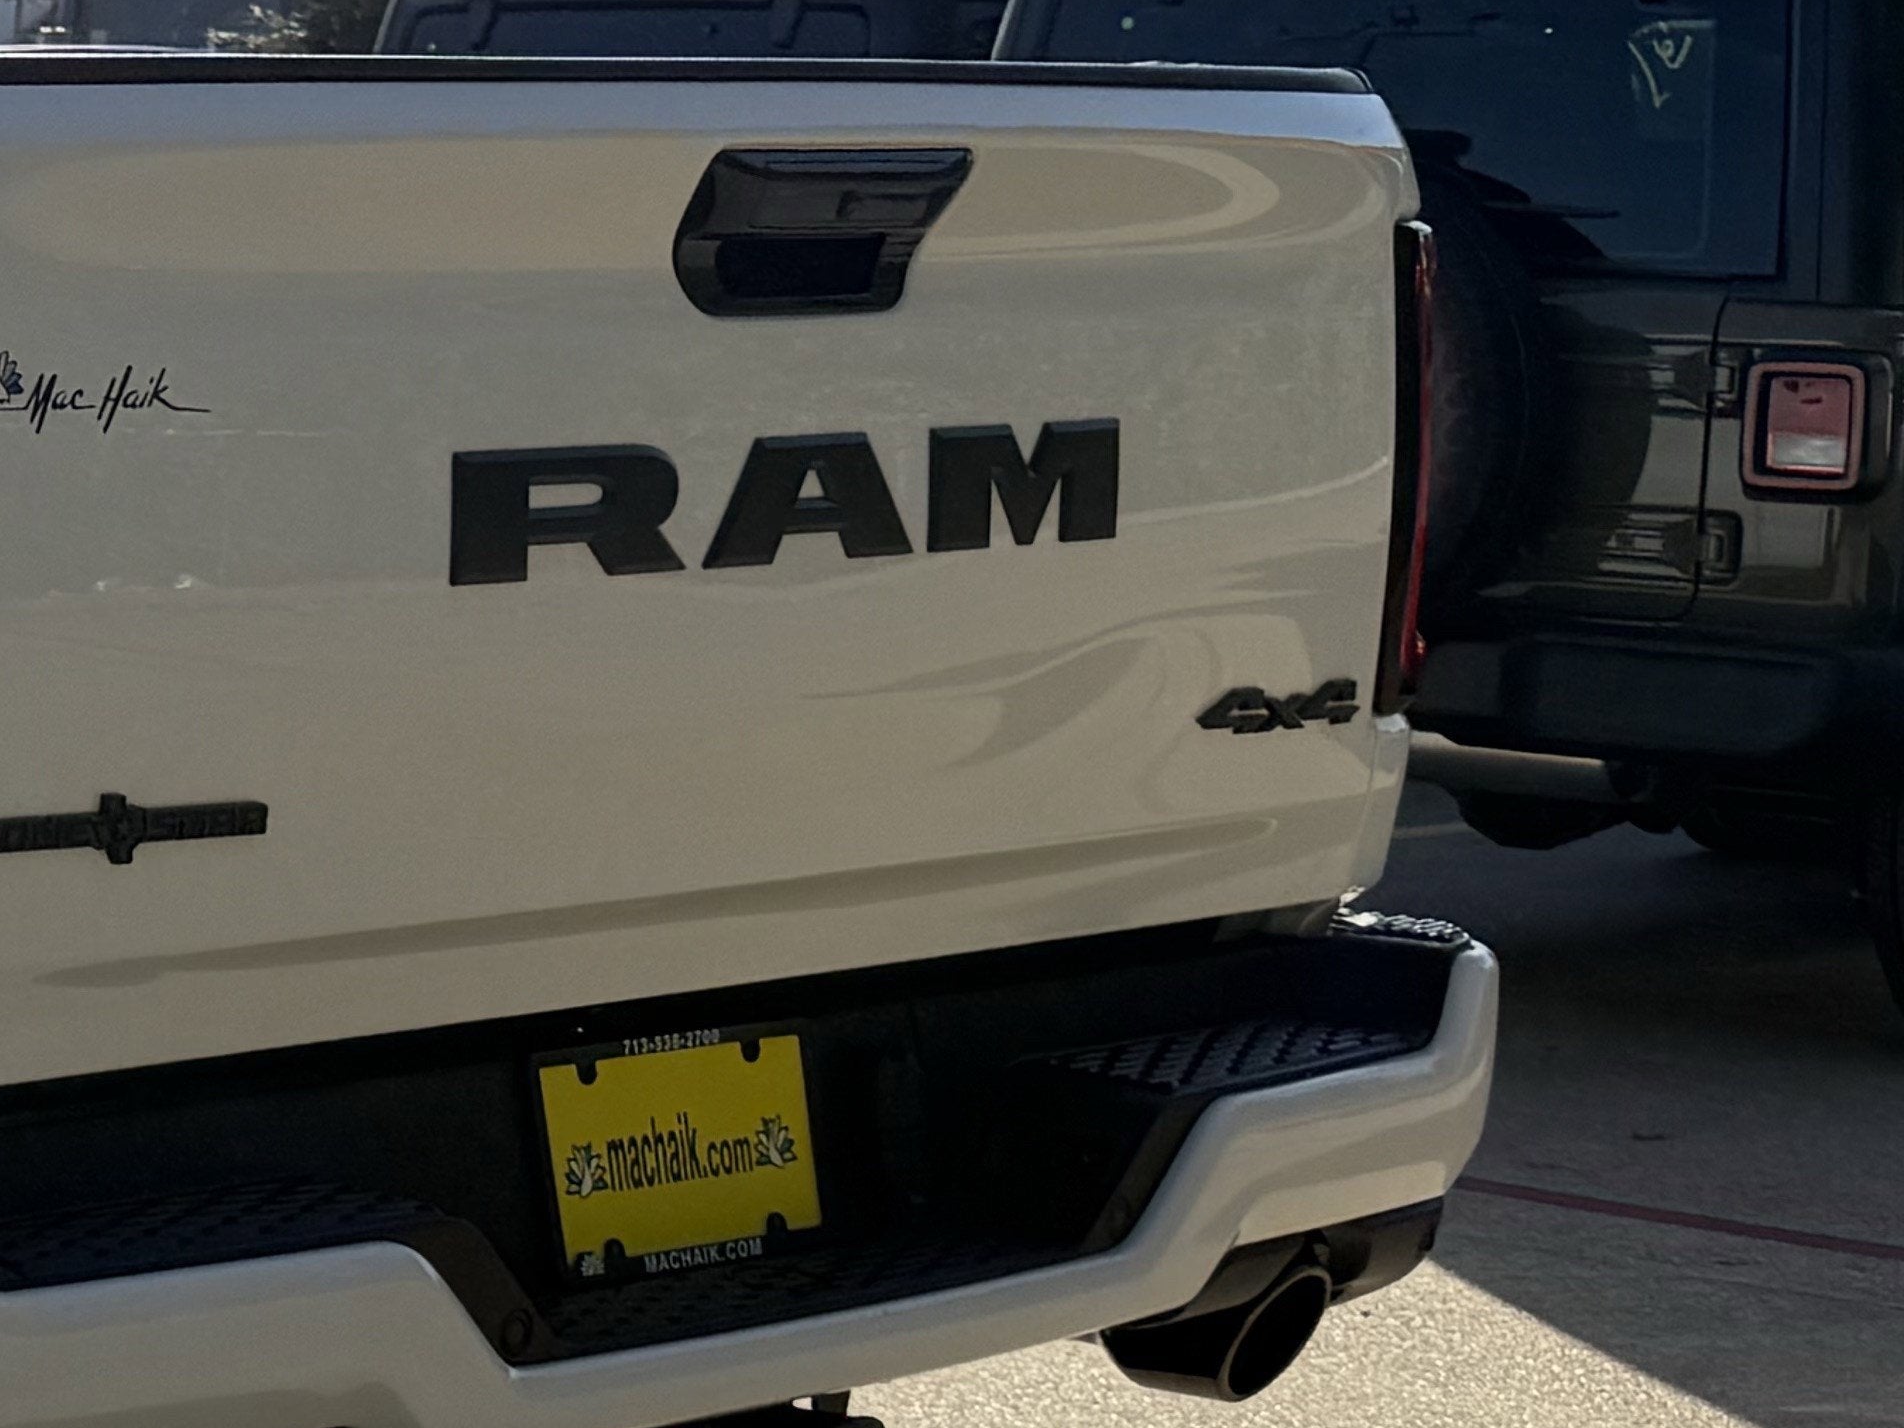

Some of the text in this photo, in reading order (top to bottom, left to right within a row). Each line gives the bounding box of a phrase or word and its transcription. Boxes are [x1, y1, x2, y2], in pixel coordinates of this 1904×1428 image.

[23, 365, 211, 434] Mac Haik
[449, 417, 1120, 586] RAM
[1195, 678, 1360, 734] 4x4
[606, 1111, 754, 1192] machaik.com
[644, 1237, 763, 1273] MACHAIK.COM
